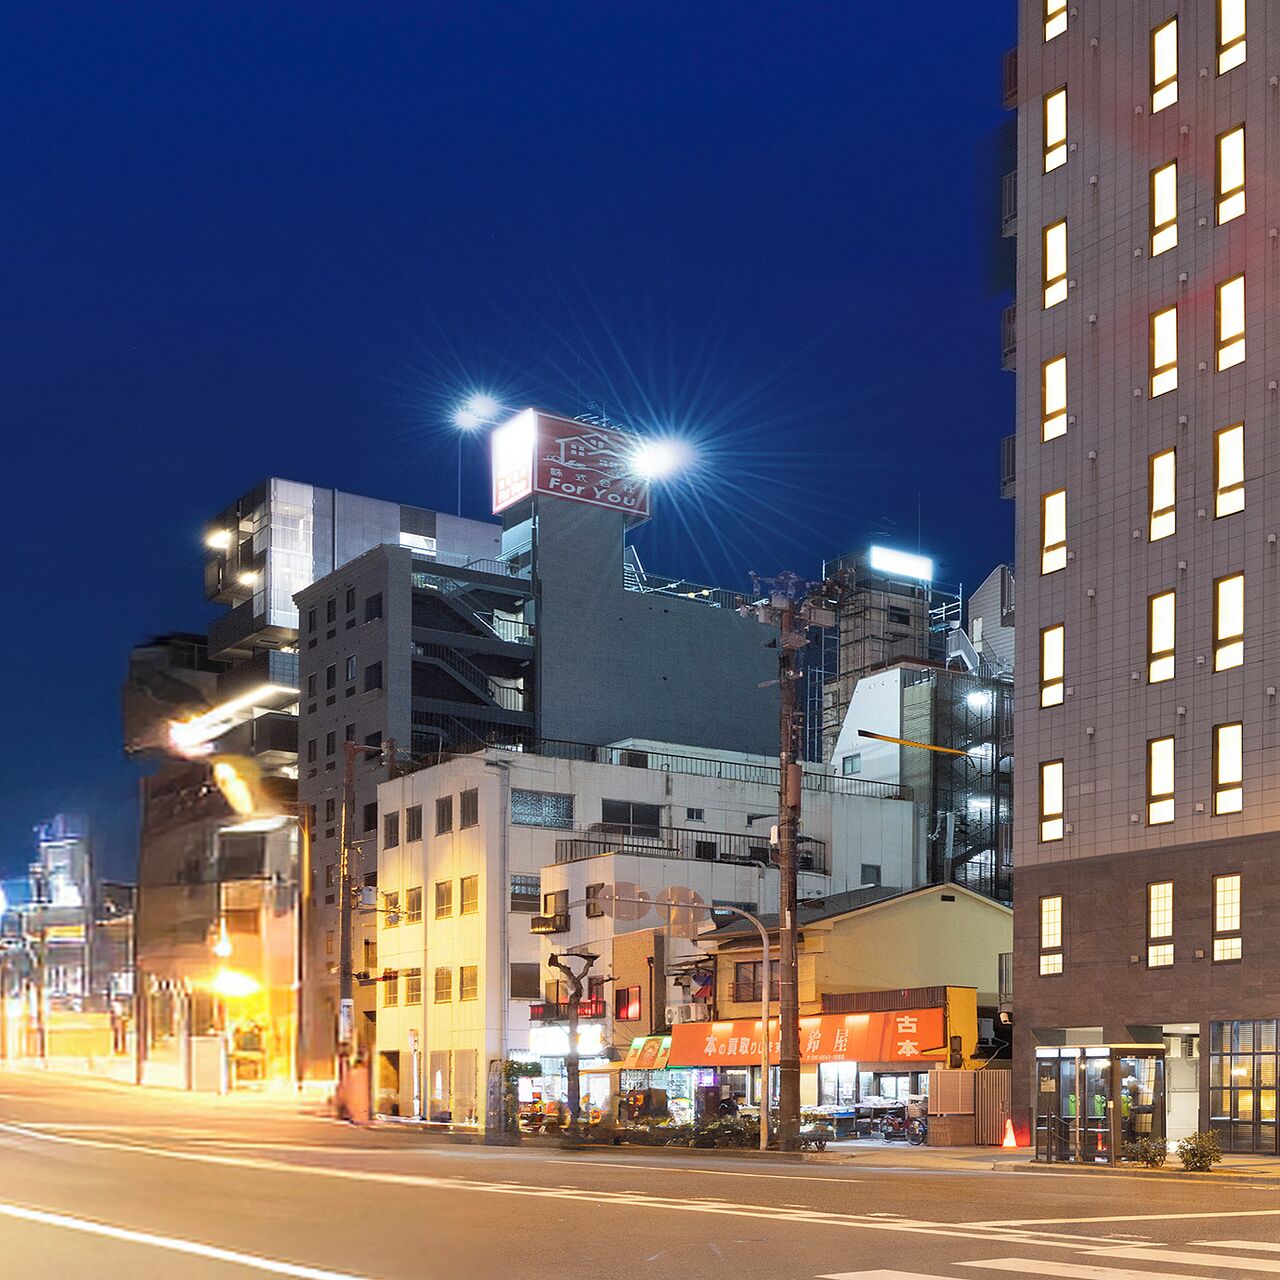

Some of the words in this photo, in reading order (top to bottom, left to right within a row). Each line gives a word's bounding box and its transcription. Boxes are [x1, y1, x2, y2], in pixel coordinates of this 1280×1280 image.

[549, 477, 585, 495] For
[592, 486, 636, 506] You
[896, 1015, 920, 1057] 古本
